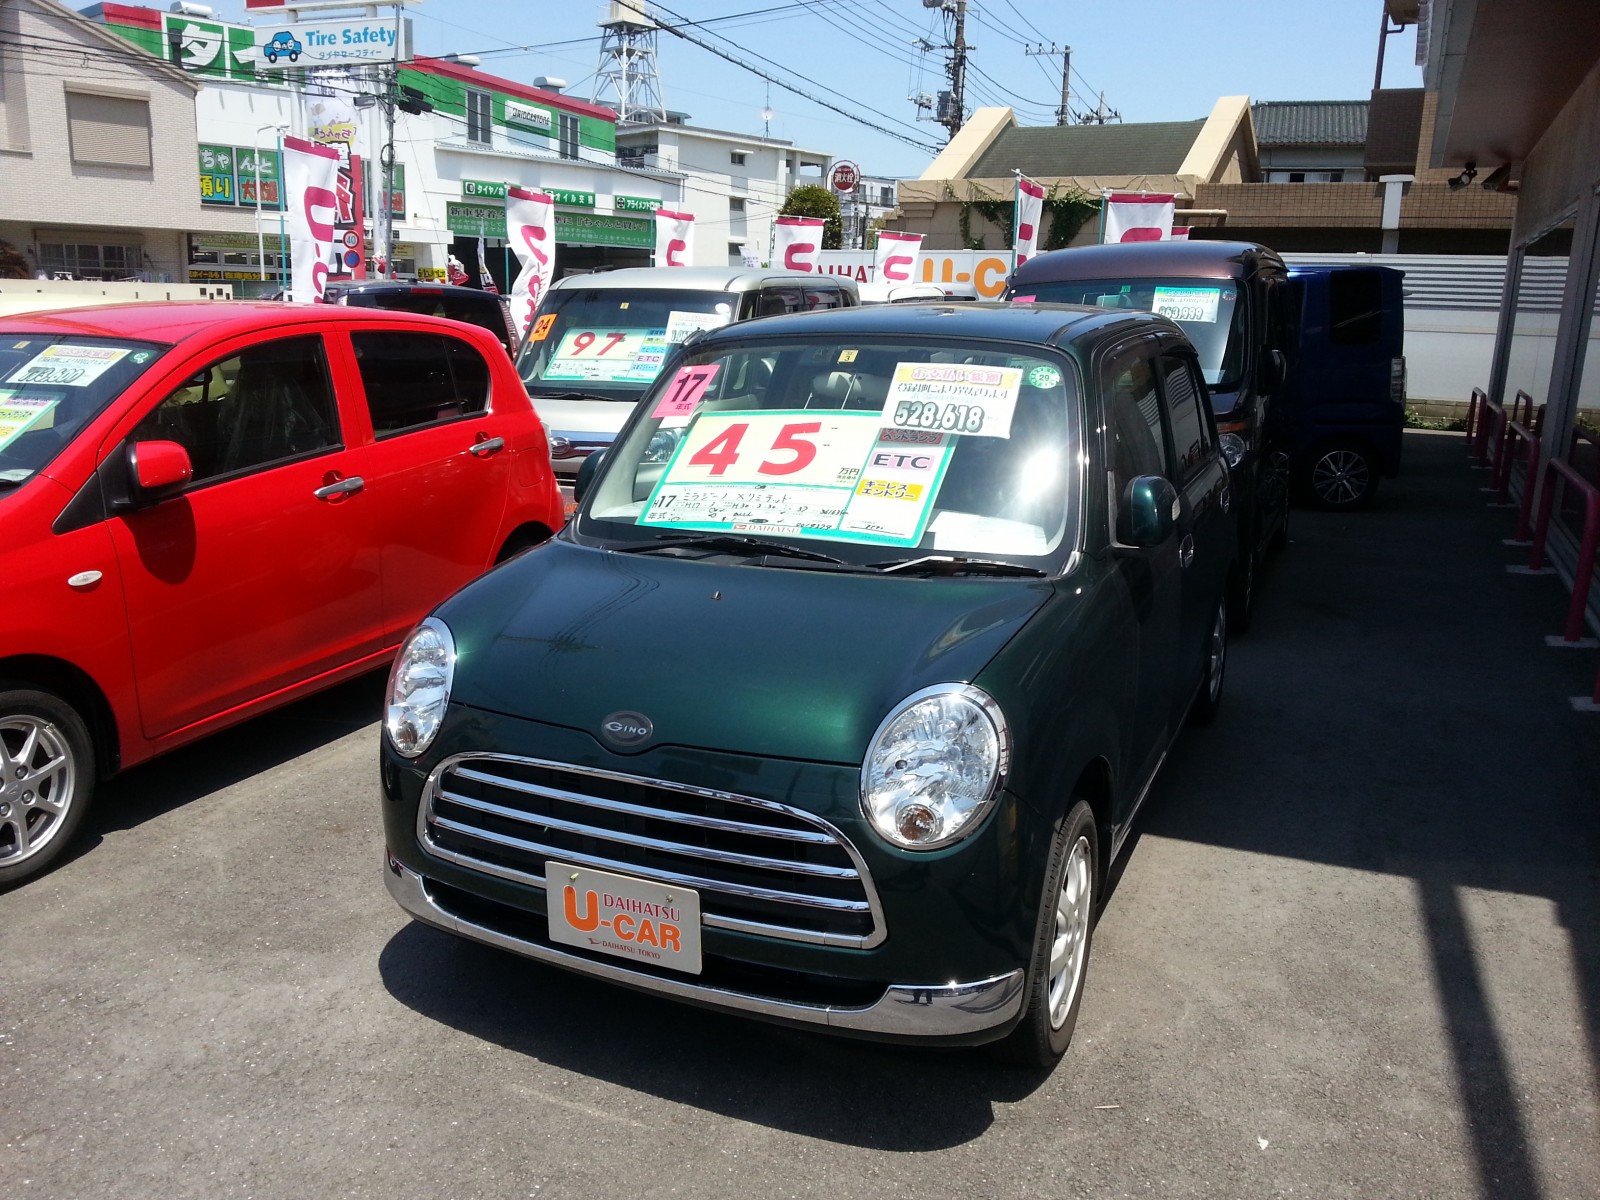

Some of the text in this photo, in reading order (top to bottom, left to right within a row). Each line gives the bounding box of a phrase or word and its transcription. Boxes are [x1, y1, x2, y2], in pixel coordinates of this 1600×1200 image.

[305, 26, 396, 47] Tire Safety
[319, 49, 382, 60] タイヤセーフティー
[834, 172, 854, 183] 消火栓
[346, 235, 356, 244] 40
[534, 318, 551, 334] 24
[571, 331, 628, 356] 97
[1038, 374, 1050, 382] 29
[671, 373, 708, 403] 17
[675, 402, 692, 410] 年式
[894, 400, 985, 433] 528,618
[688, 422, 822, 476] 45
[873, 453, 931, 469] ETC
[838, 467, 860, 476] 万円
[862, 488, 914, 498] エントリー
[865, 481, 907, 491] キーレス
[648, 511, 668, 519] 年式
[748, 524, 800, 534] DAIHATSU
[604, 721, 647, 736] GINO
[603, 893, 680, 922] DAIHATSU
[563, 885, 681, 953] U-CAR
[602, 940, 661, 959] DAIHATSU TOKYO
